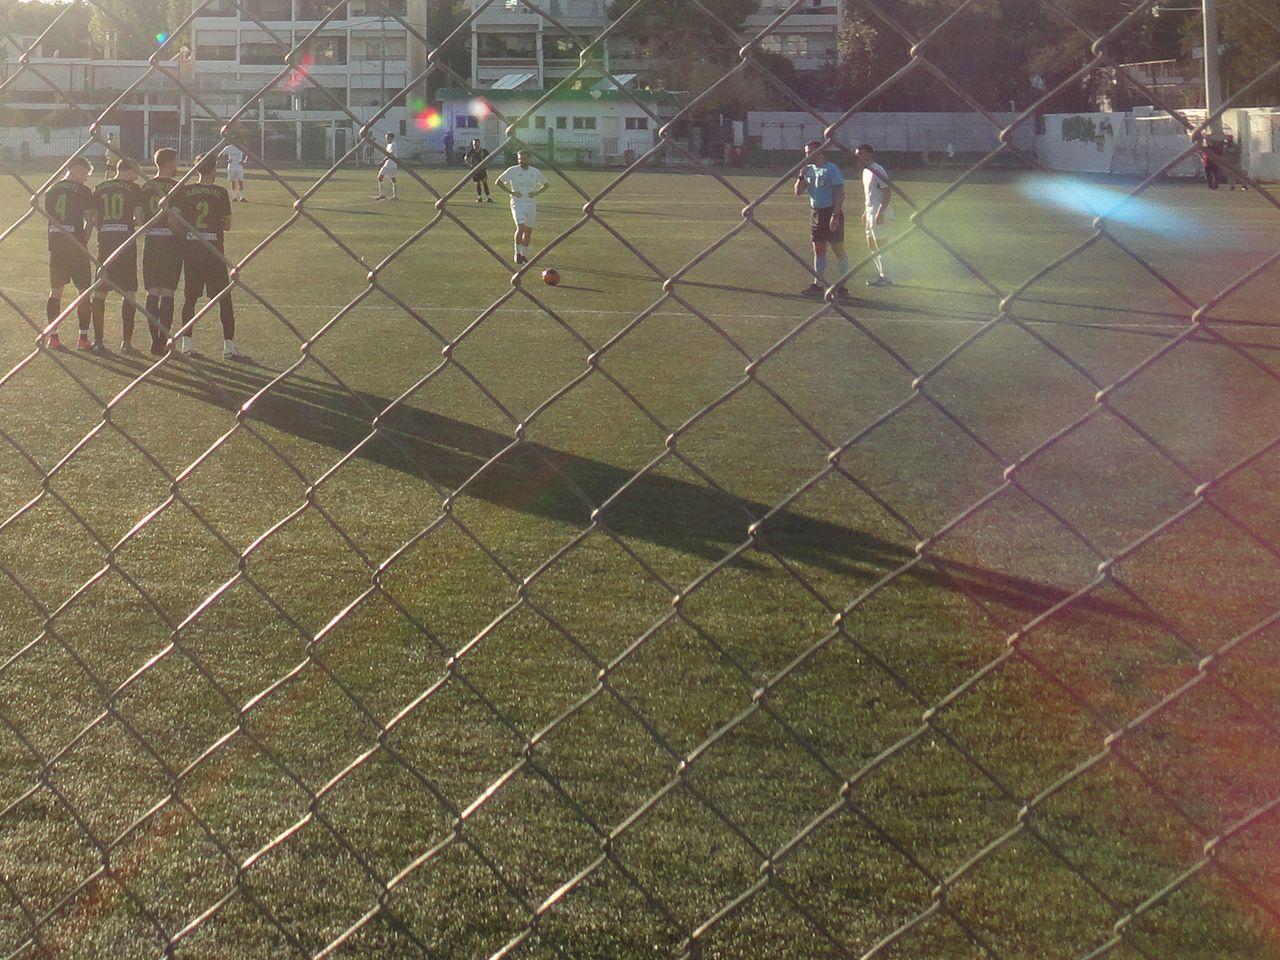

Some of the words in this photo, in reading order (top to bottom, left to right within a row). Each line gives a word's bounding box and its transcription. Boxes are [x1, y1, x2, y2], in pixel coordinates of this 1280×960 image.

[55, 193, 68, 222] 4
[100, 193, 124, 221] 10
[196, 200, 210, 228] 2
